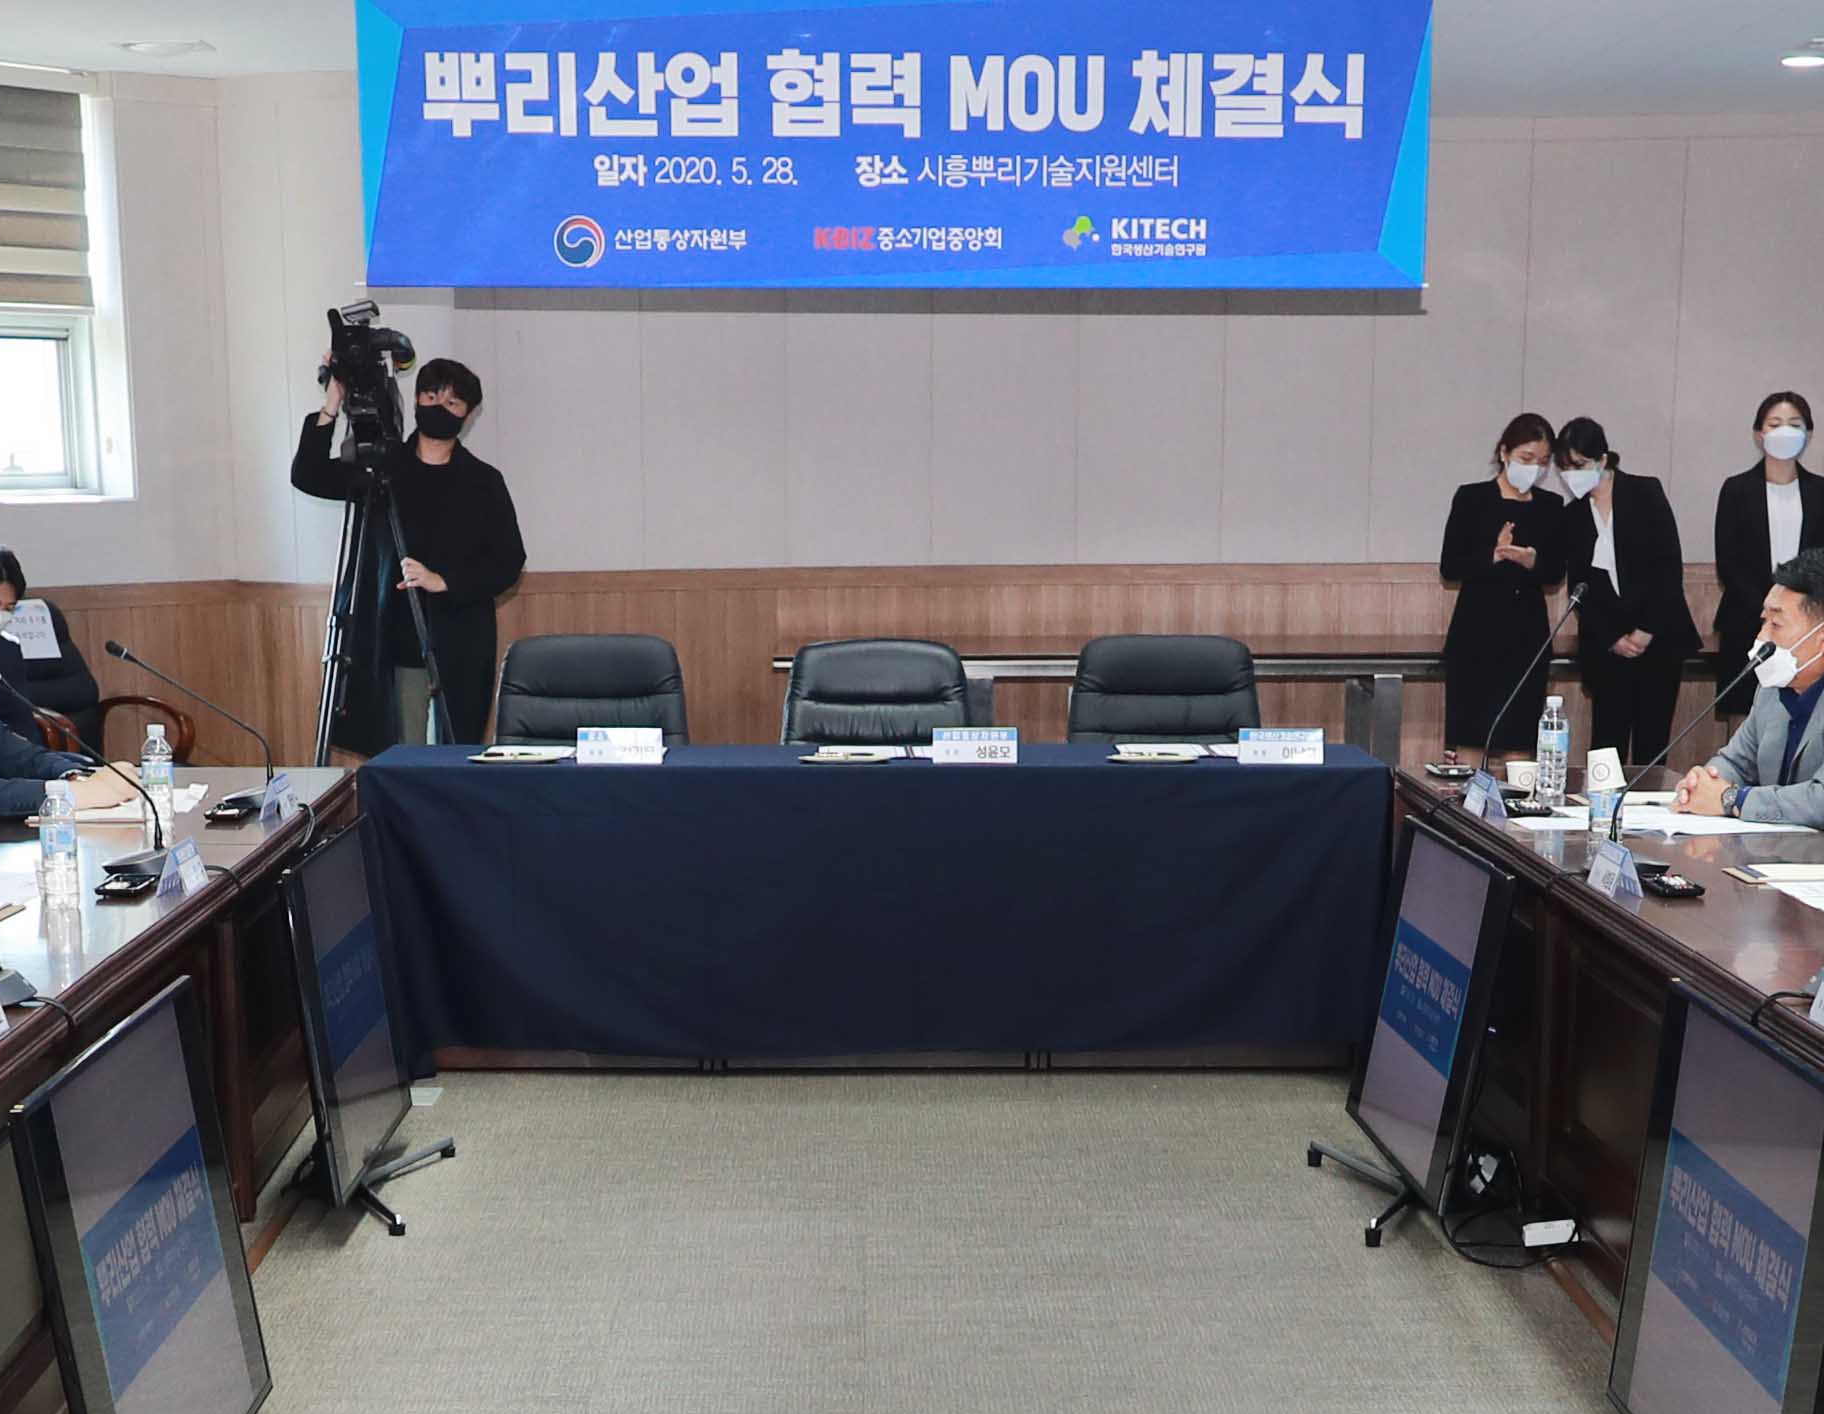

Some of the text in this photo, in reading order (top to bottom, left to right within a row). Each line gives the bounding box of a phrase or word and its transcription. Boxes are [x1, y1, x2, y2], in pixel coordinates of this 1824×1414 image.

[423, 48, 1365, 139] 뿌리산업 협력 MOU 체결식
[593, 154, 1179, 188] 일자 2020. 5. 28. 장소 시흥뿌리기술지원센터
[614, 228, 747, 251] 산업통상자원부
[877, 226, 1003, 251] 중소기업중앙회
[1111, 218, 1207, 240] KITECH
